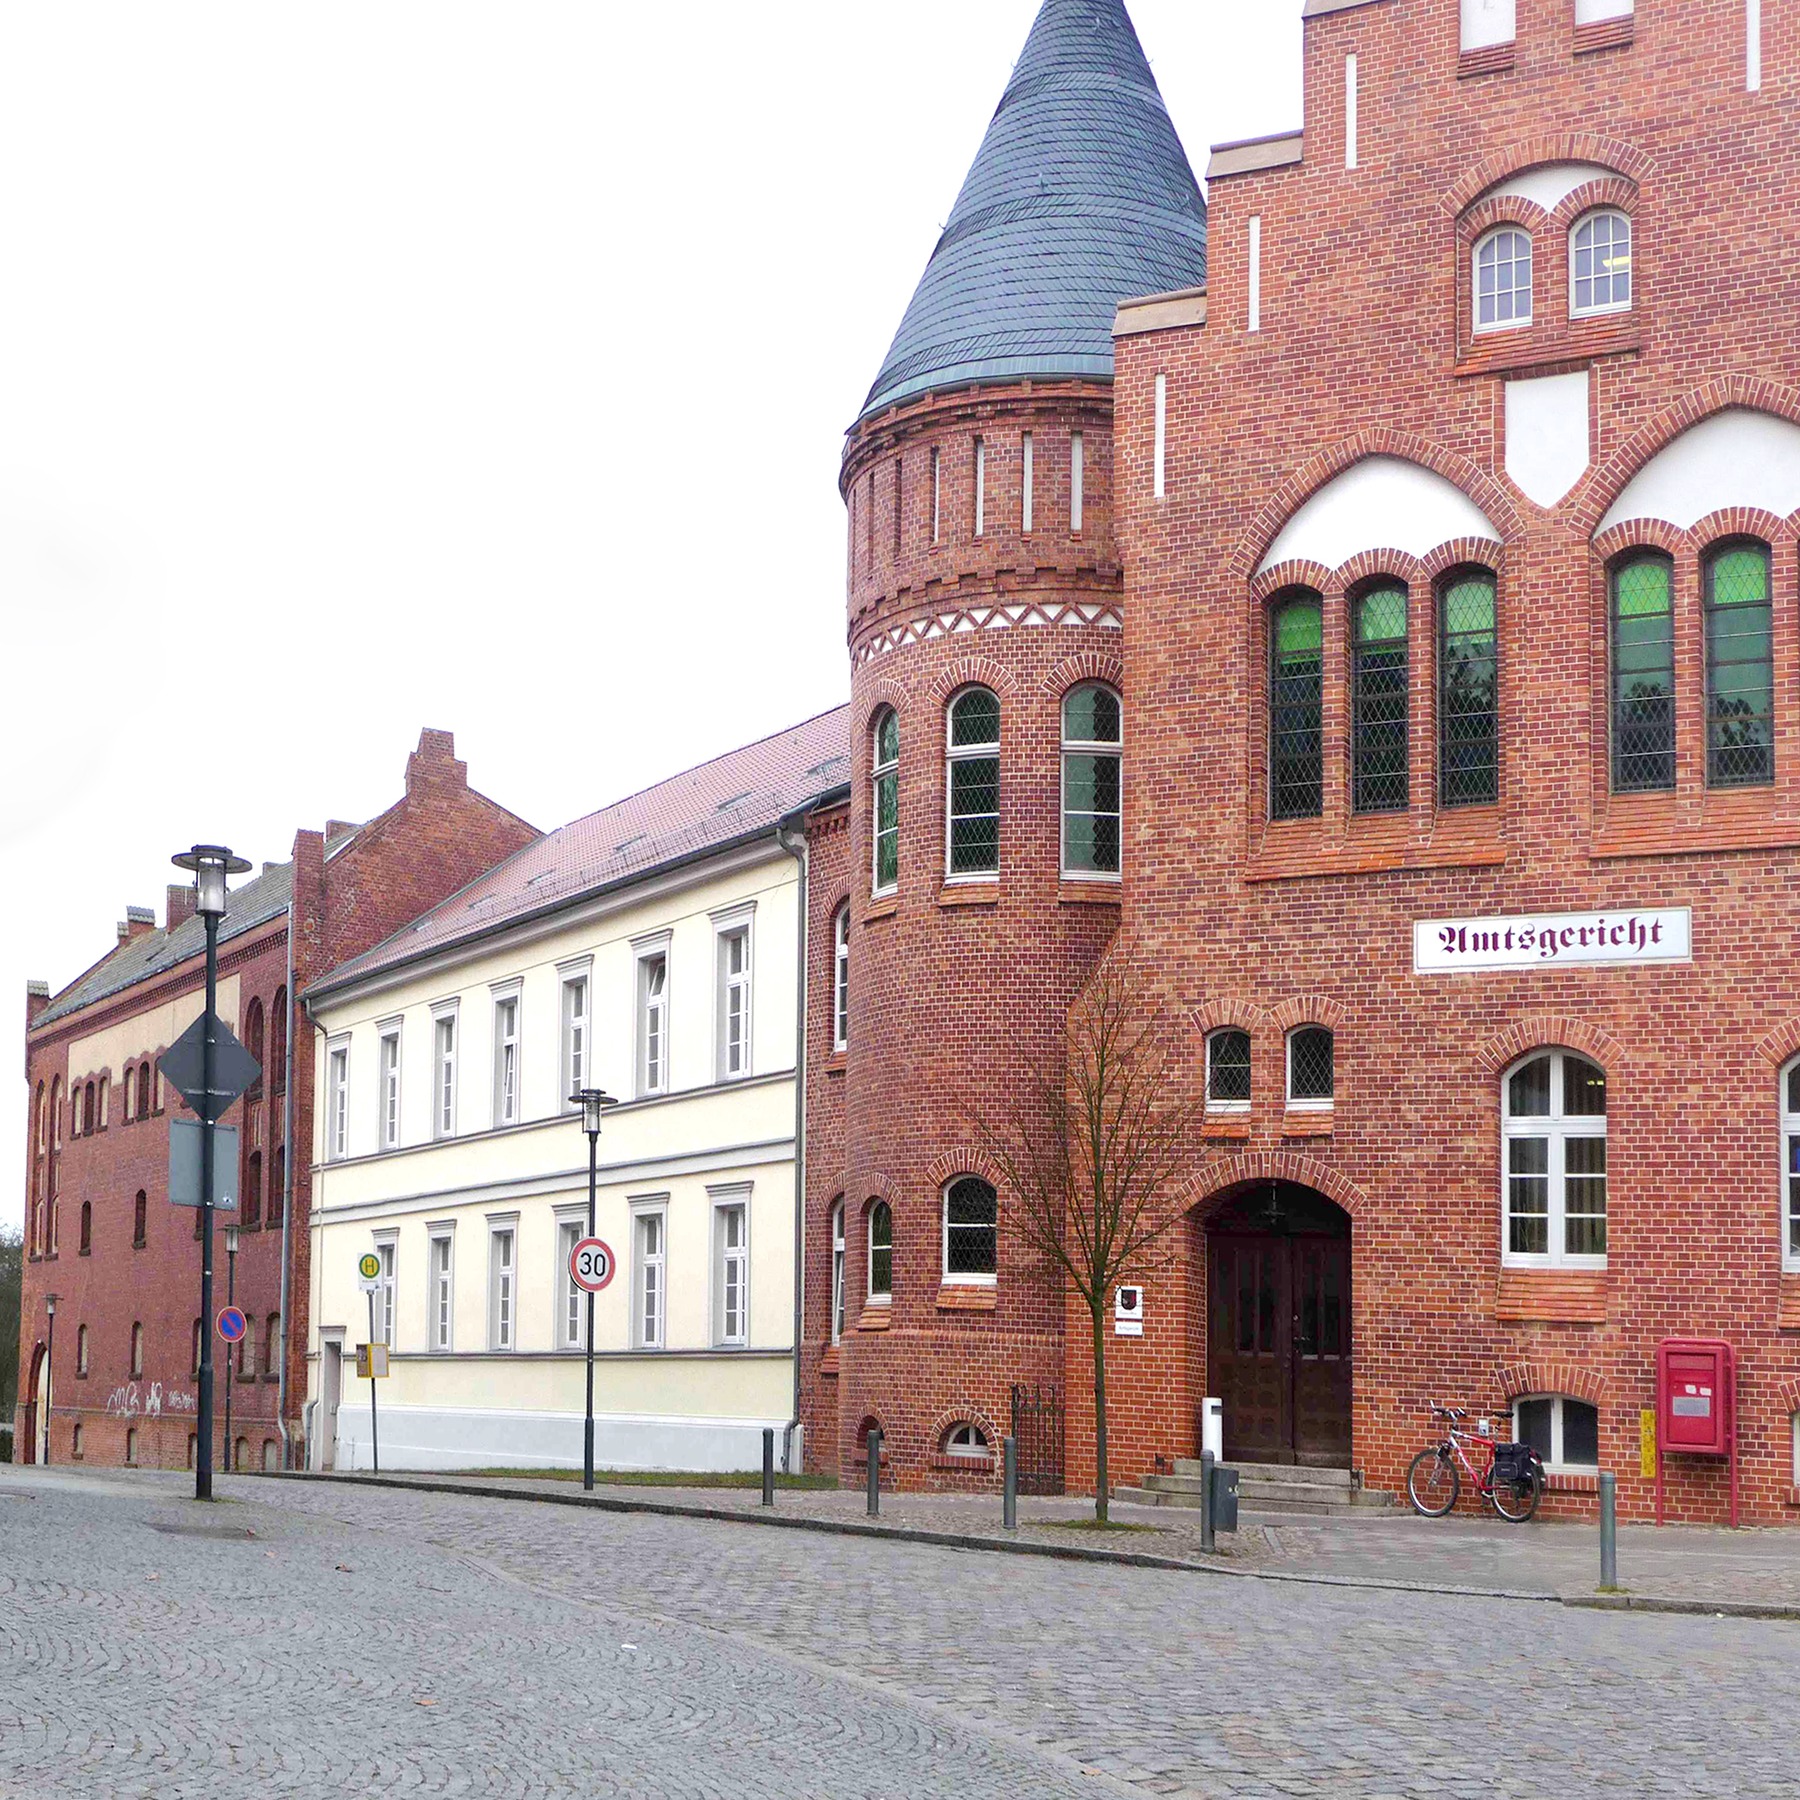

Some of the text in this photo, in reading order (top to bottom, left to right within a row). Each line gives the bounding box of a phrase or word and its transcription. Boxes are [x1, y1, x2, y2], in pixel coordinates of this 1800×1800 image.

[1438, 916, 1664, 959] Amtsgericht
[365, 1259, 374, 1273] H
[580, 1252, 606, 1277] 30
